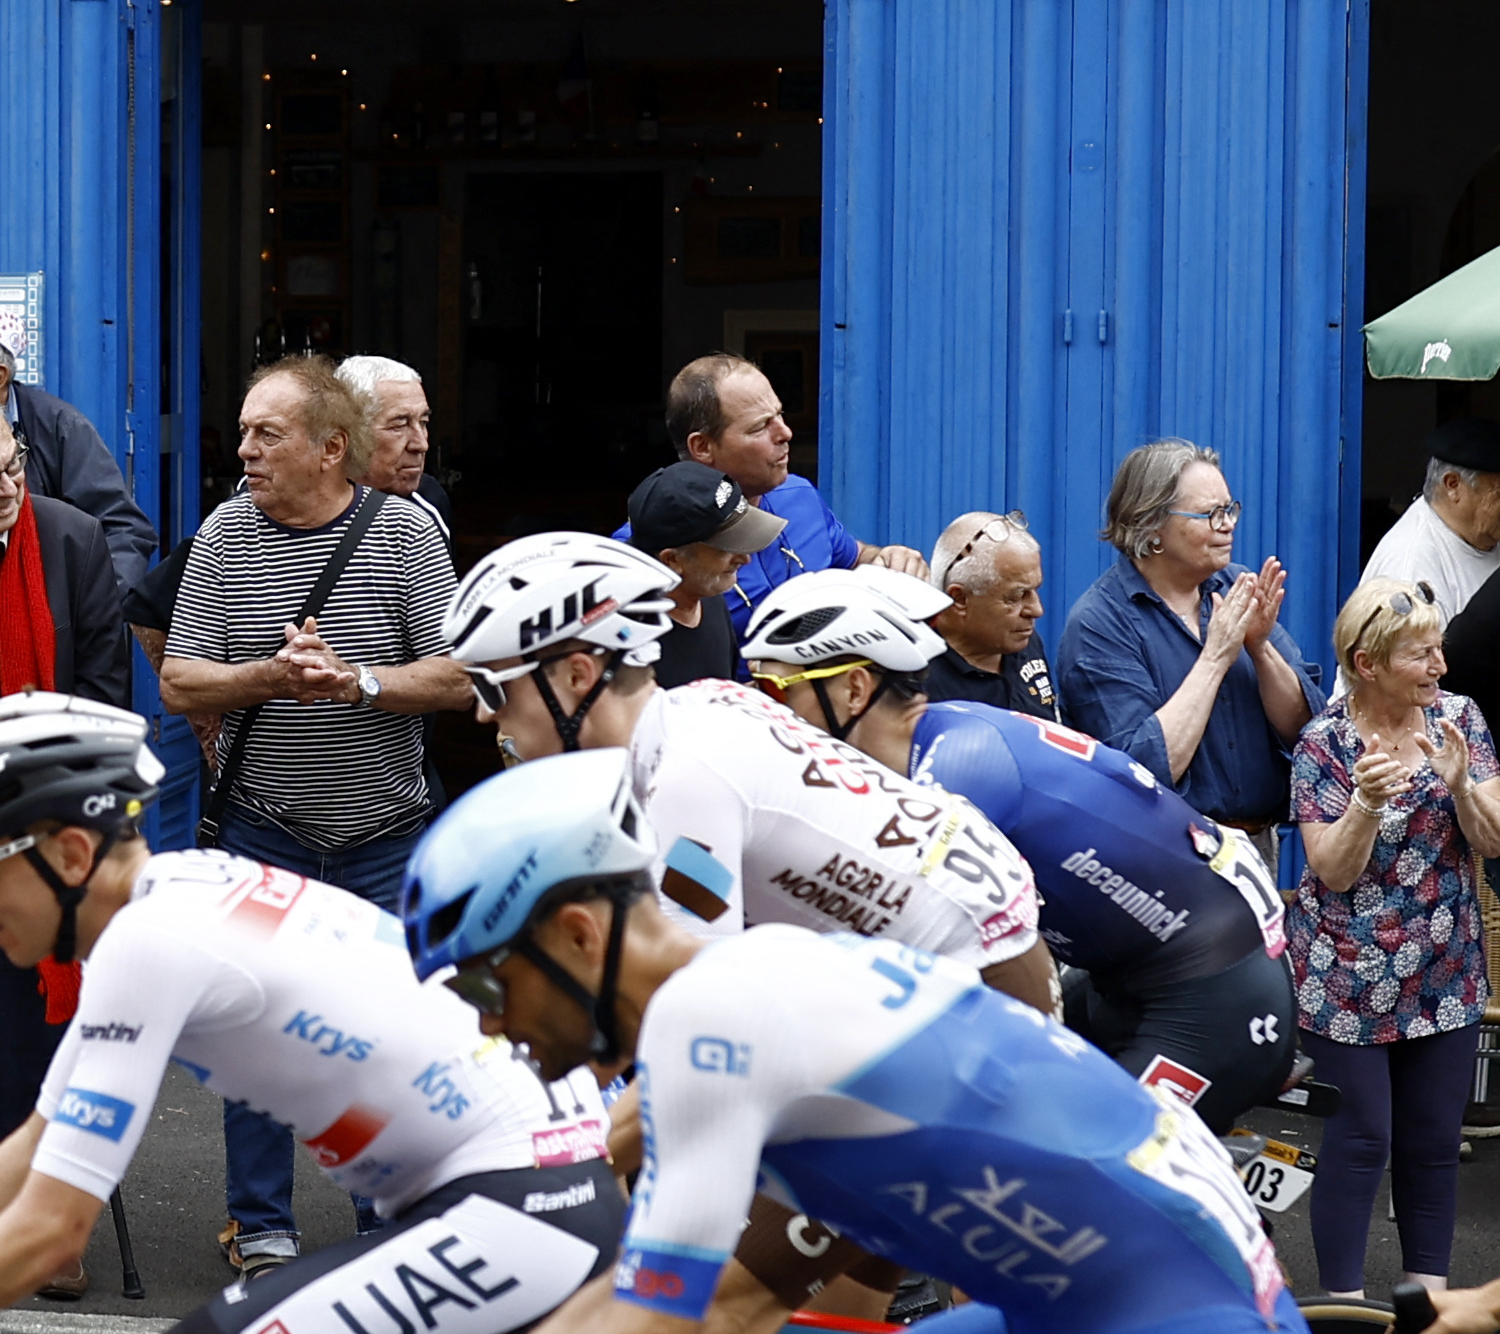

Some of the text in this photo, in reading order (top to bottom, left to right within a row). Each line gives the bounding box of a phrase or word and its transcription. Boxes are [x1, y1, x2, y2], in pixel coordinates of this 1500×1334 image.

[519, 575, 608, 653] HJC
[794, 628, 890, 659] CANYON
[1063, 848, 1188, 943] deceuninck
[80, 1023, 144, 1044] antini
[283, 1010, 375, 1064] Krys
[58, 1091, 117, 1129] Krys
[413, 1061, 470, 1121] Krys
[1241, 1161, 1284, 1205] 03
